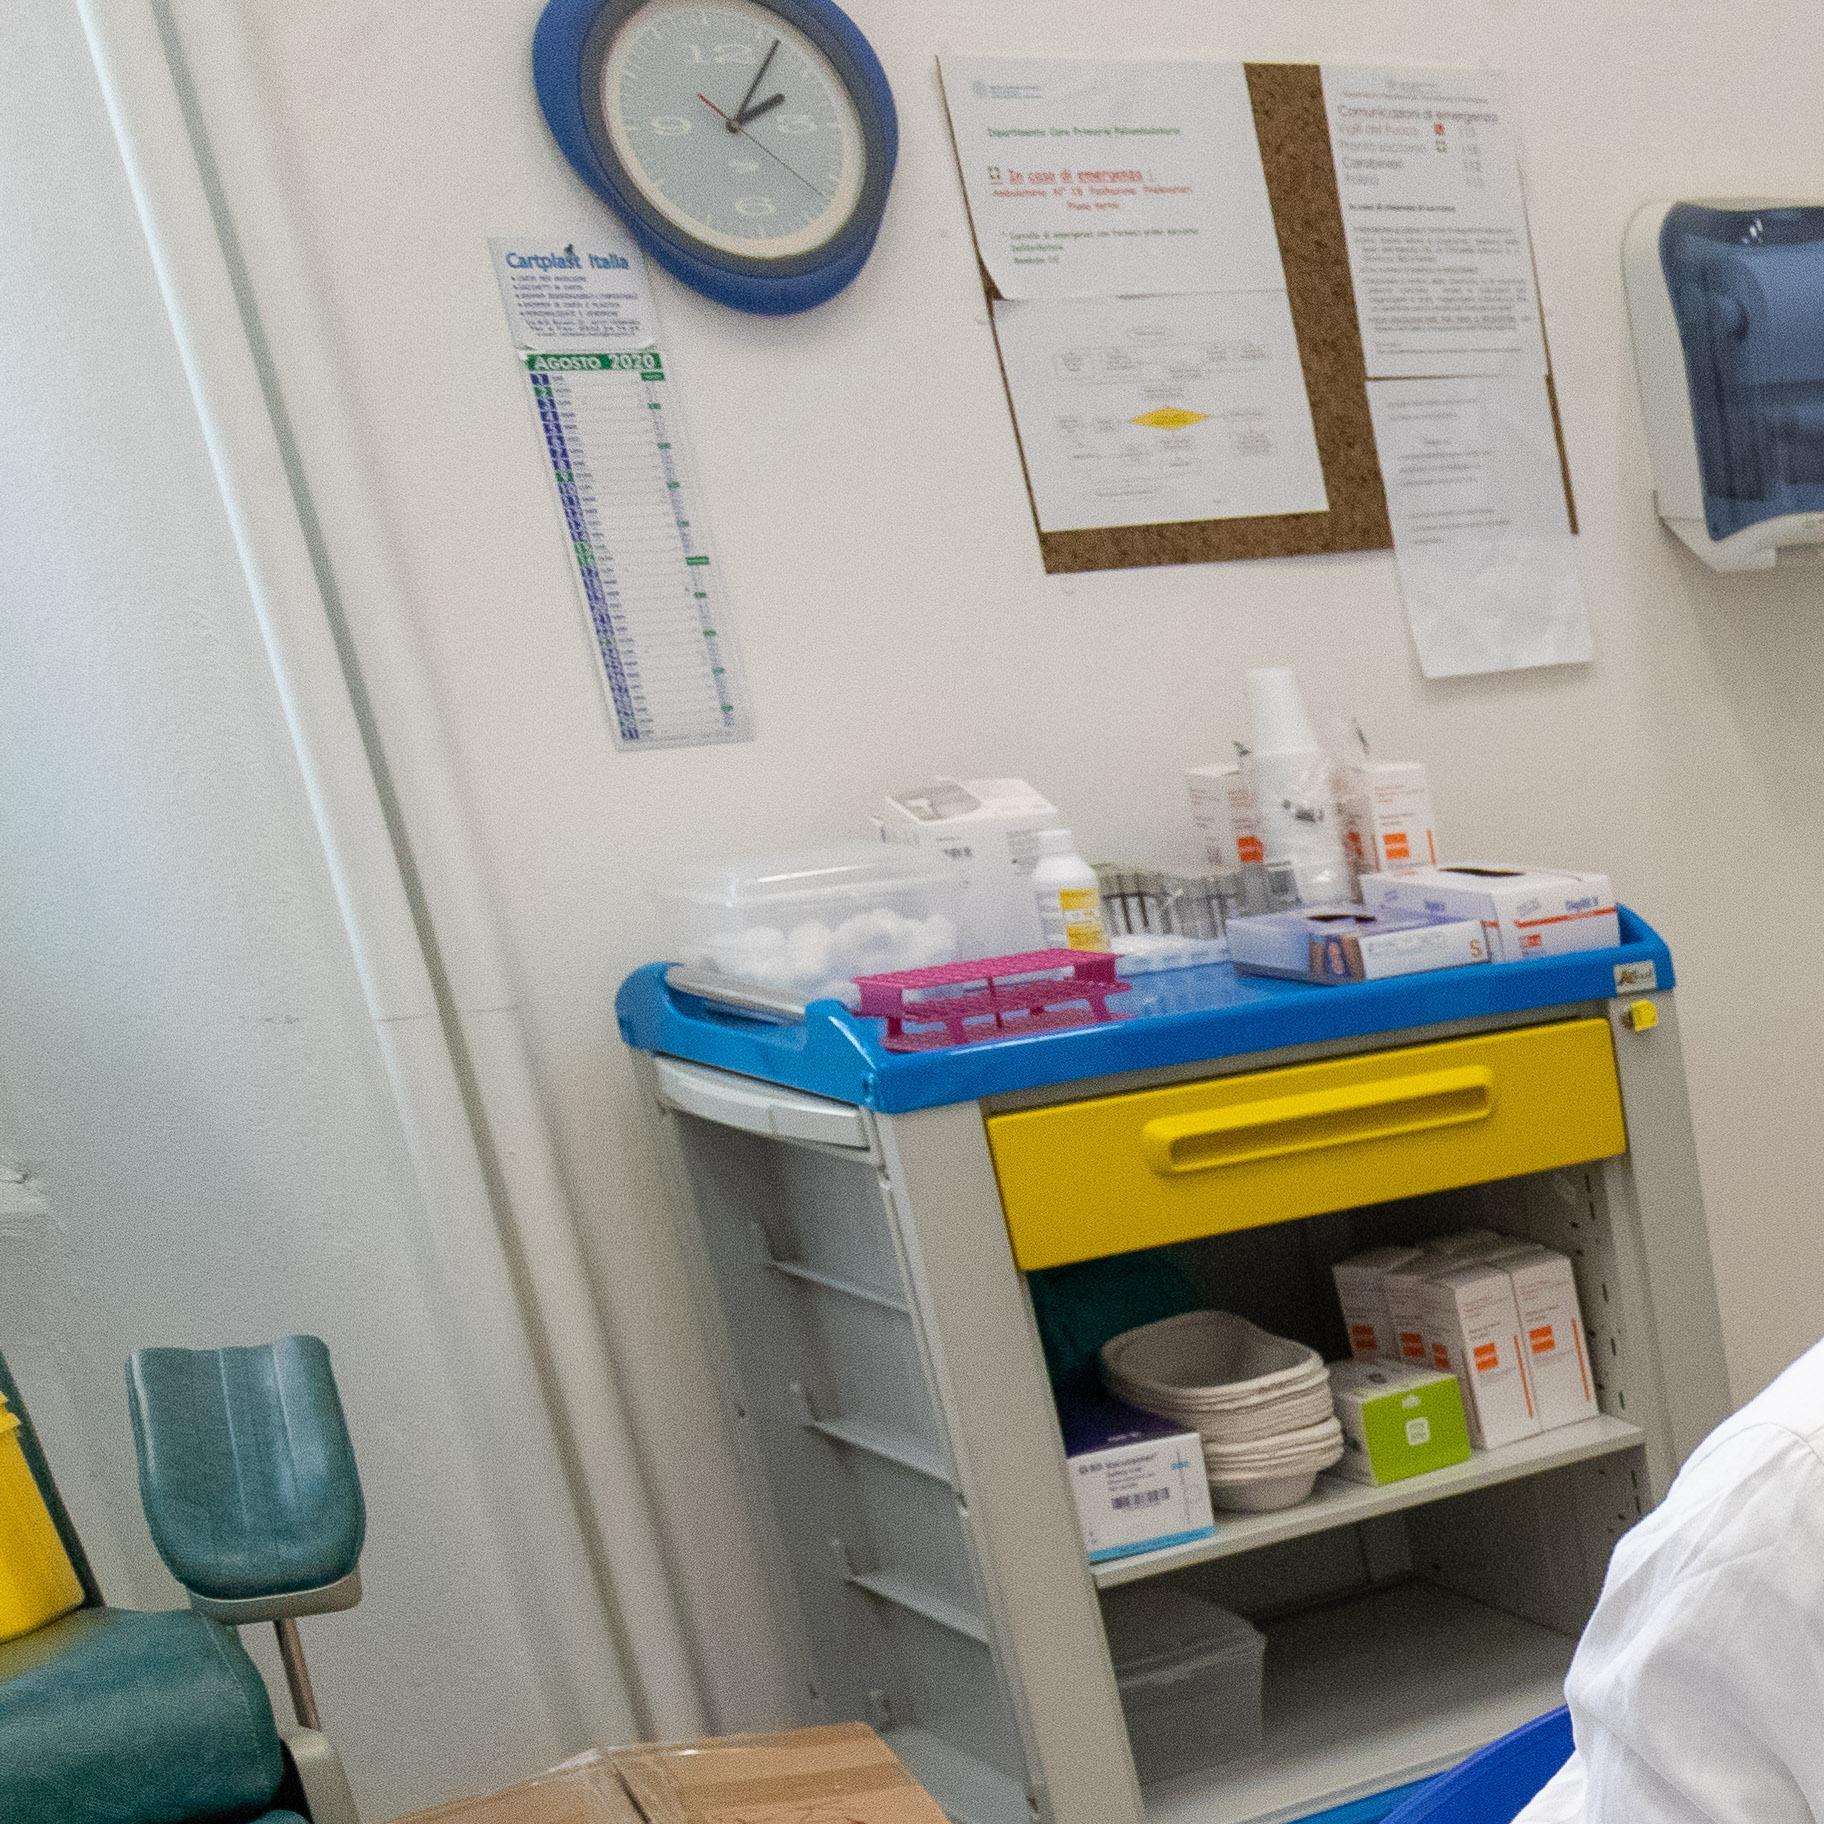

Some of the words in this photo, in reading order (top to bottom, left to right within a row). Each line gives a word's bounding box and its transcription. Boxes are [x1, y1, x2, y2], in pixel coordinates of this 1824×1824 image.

[684, 44, 756, 64] 12
[651, 115, 692, 137] 9
[776, 114, 817, 134] 3
[1008, 169, 1024, 184] In
[1028, 171, 1056, 184] caso
[1060, 169, 1073, 183] di
[1077, 170, 1143, 184] emergenza
[735, 196, 775, 217] 6
[506, 252, 582, 272] Cartplast
[589, 253, 630, 270] Italia
[534, 356, 601, 370] AGOSTO
[609, 354, 655, 369] 2020
[1470, 939, 1482, 958] S
